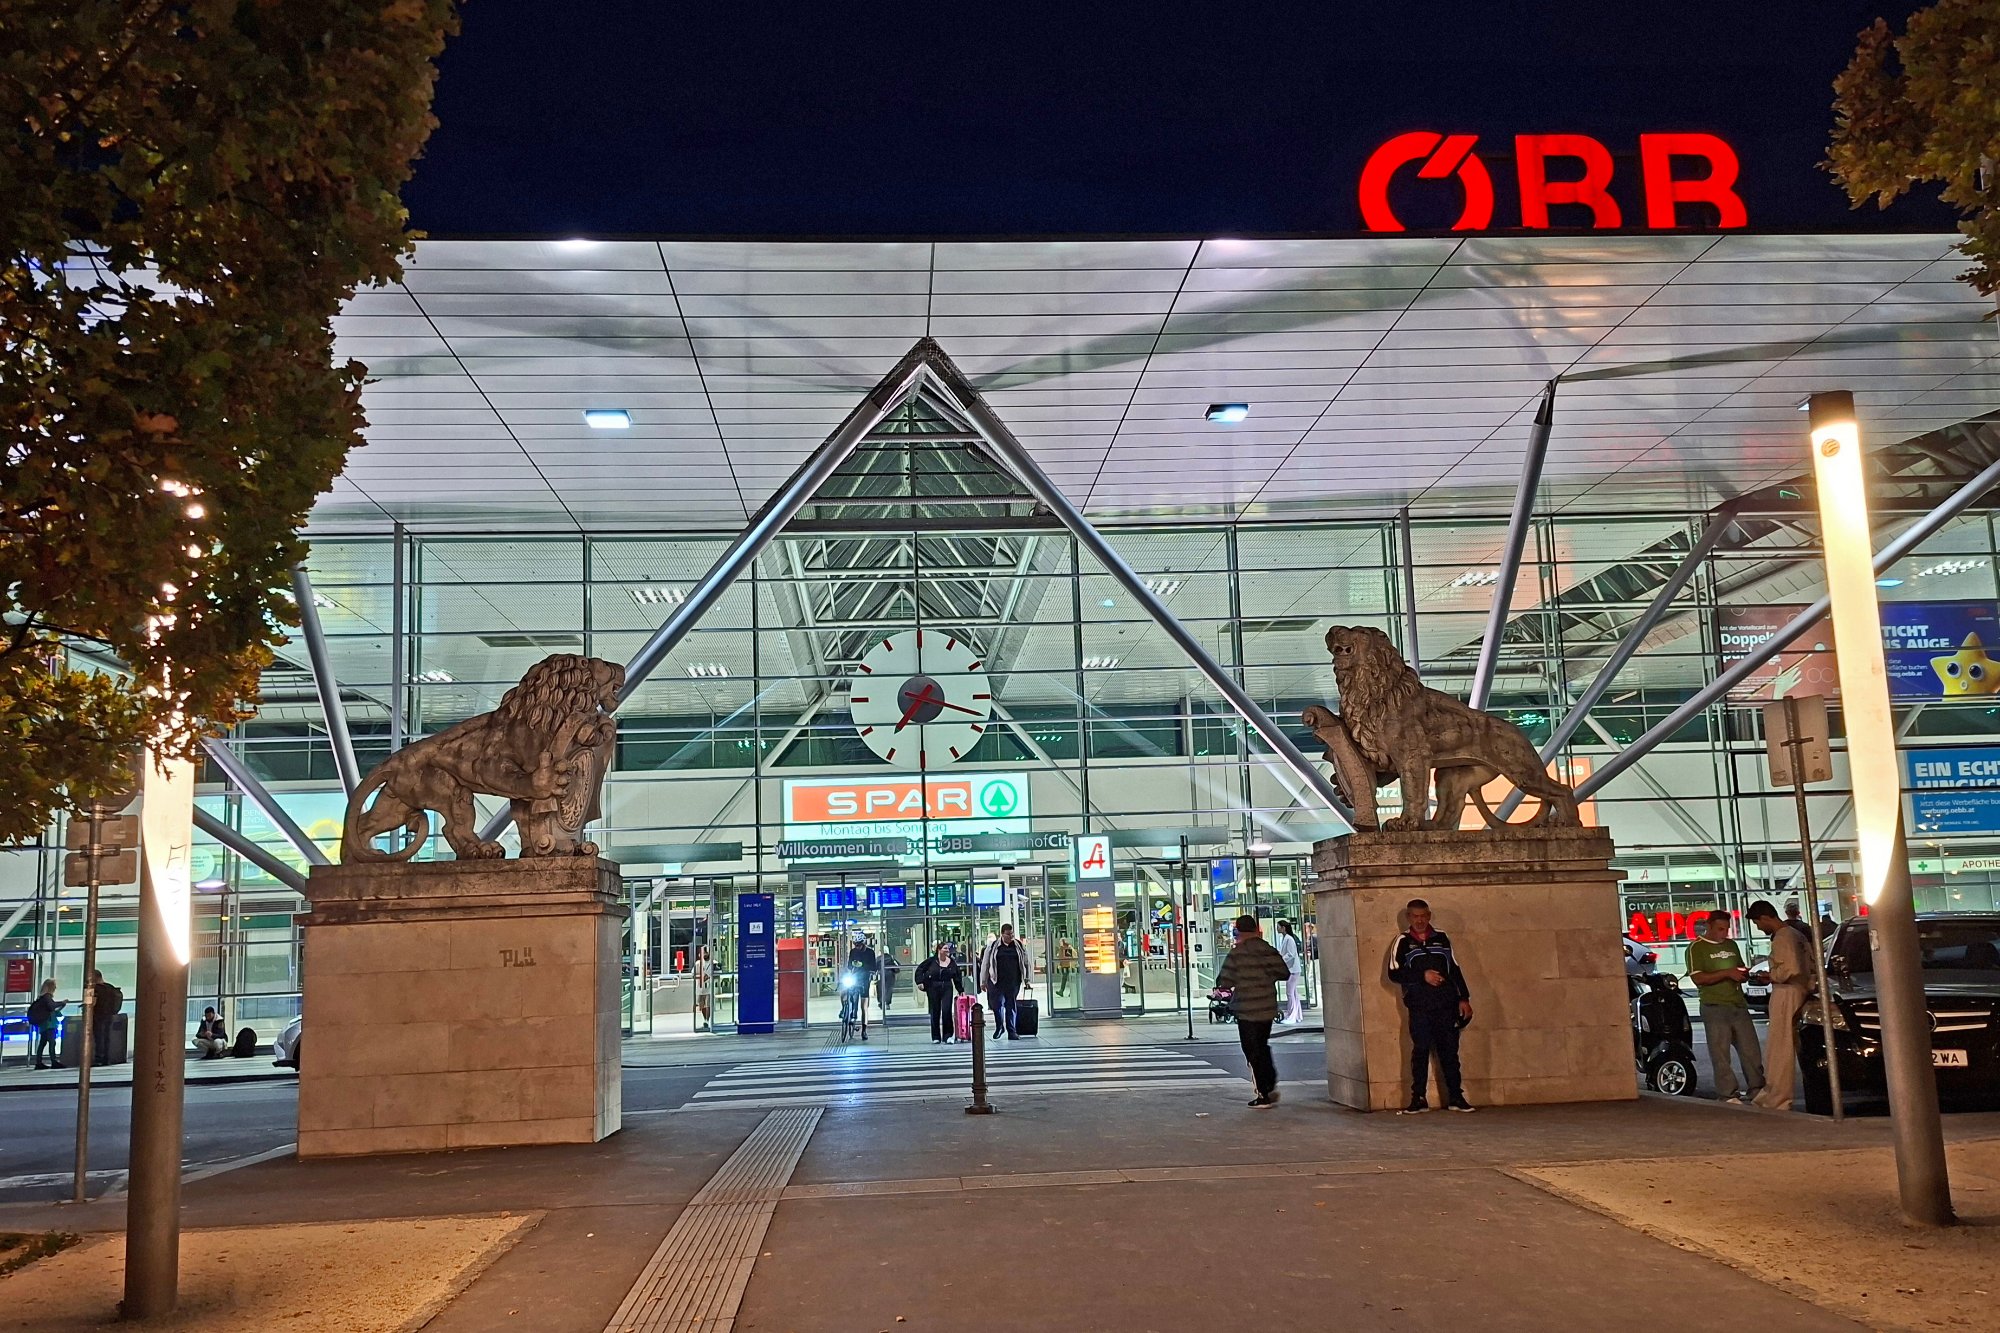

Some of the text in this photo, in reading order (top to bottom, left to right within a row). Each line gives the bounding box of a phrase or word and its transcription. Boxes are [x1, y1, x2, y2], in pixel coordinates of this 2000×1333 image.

[1881, 625, 1929, 637] TICHT
[1914, 762, 1952, 777] EIN
[827, 788, 969, 815] SPAR
[820, 824, 871, 838] Montag
[874, 822, 891, 834] bis
[775, 841, 865, 857] Willkommen
[869, 841, 883, 853] in
